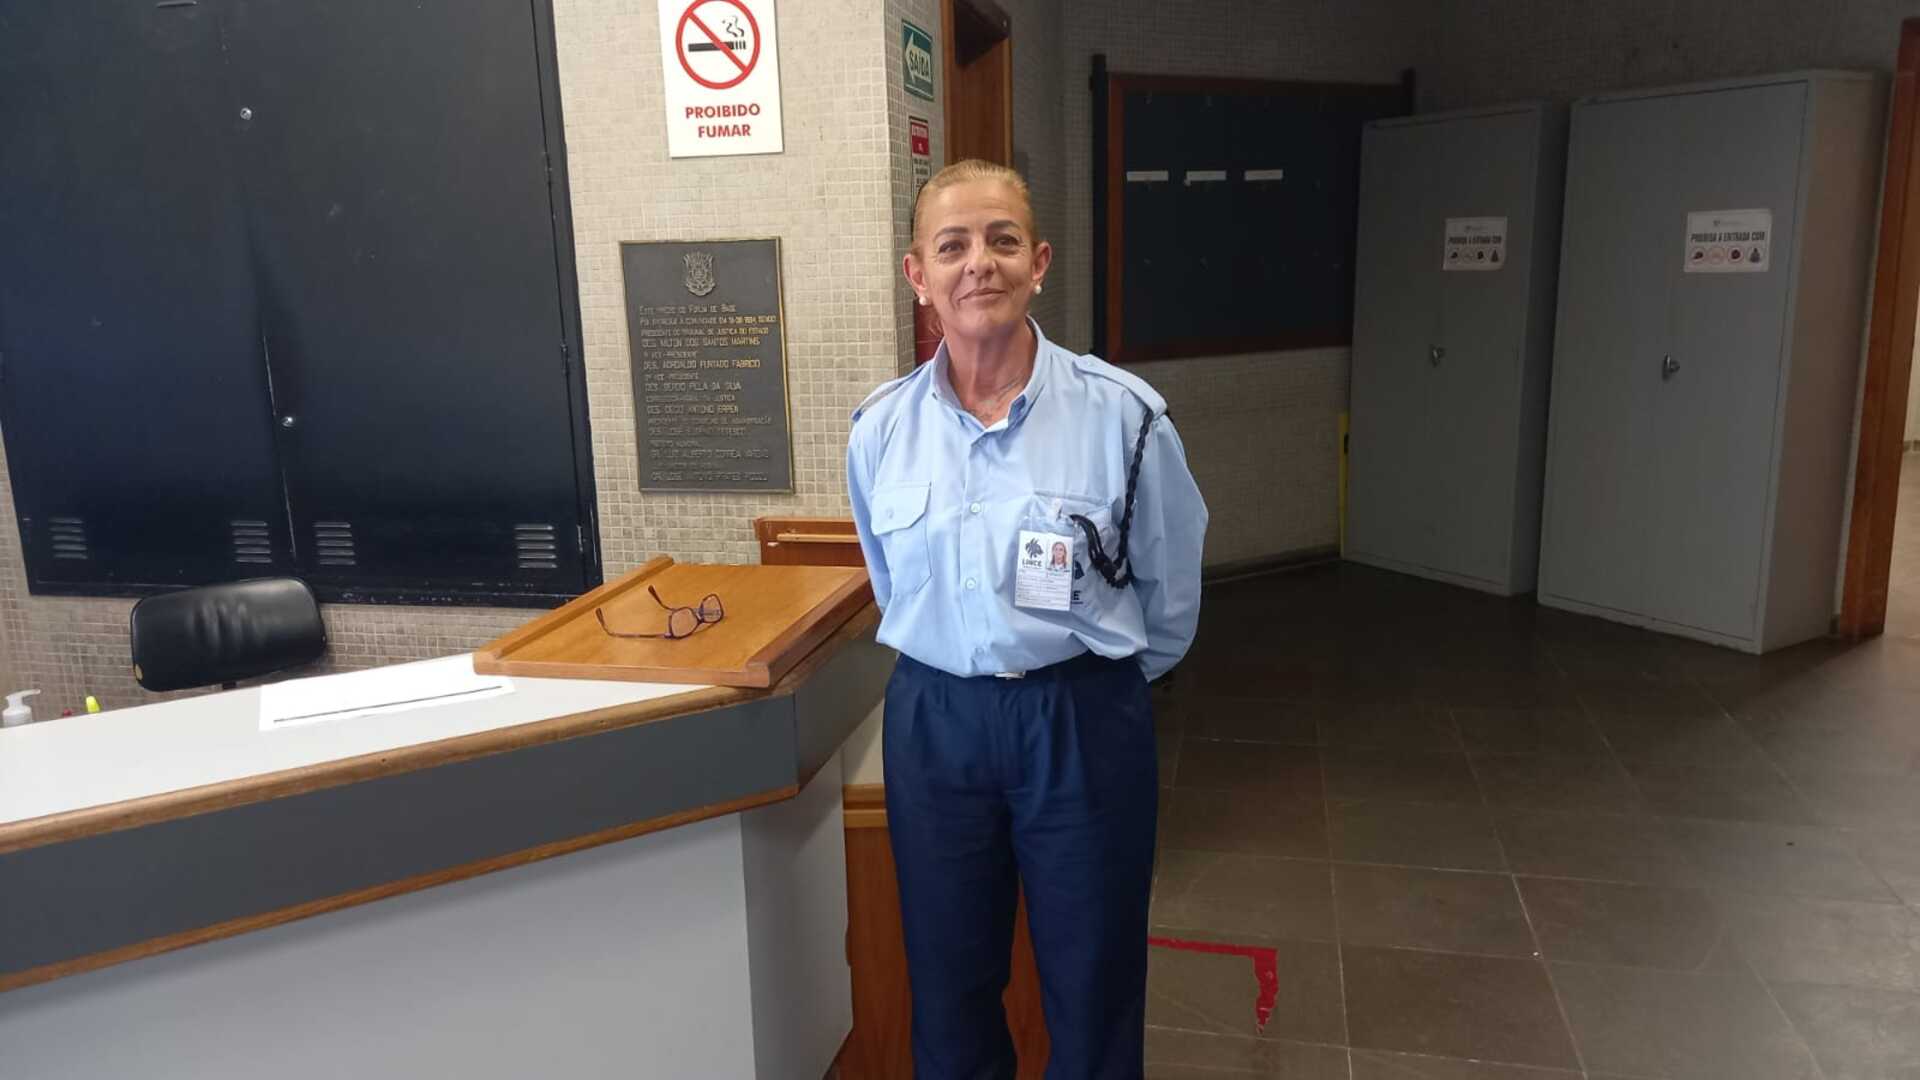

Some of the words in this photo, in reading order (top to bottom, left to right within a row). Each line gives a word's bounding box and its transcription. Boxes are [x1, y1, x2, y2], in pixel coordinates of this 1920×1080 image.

[685, 103, 760, 119] PROIBIDO
[698, 124, 751, 138] FUMAR
[1724, 231, 1750, 242] ENTRADA
[1751, 231, 1765, 241] COM
